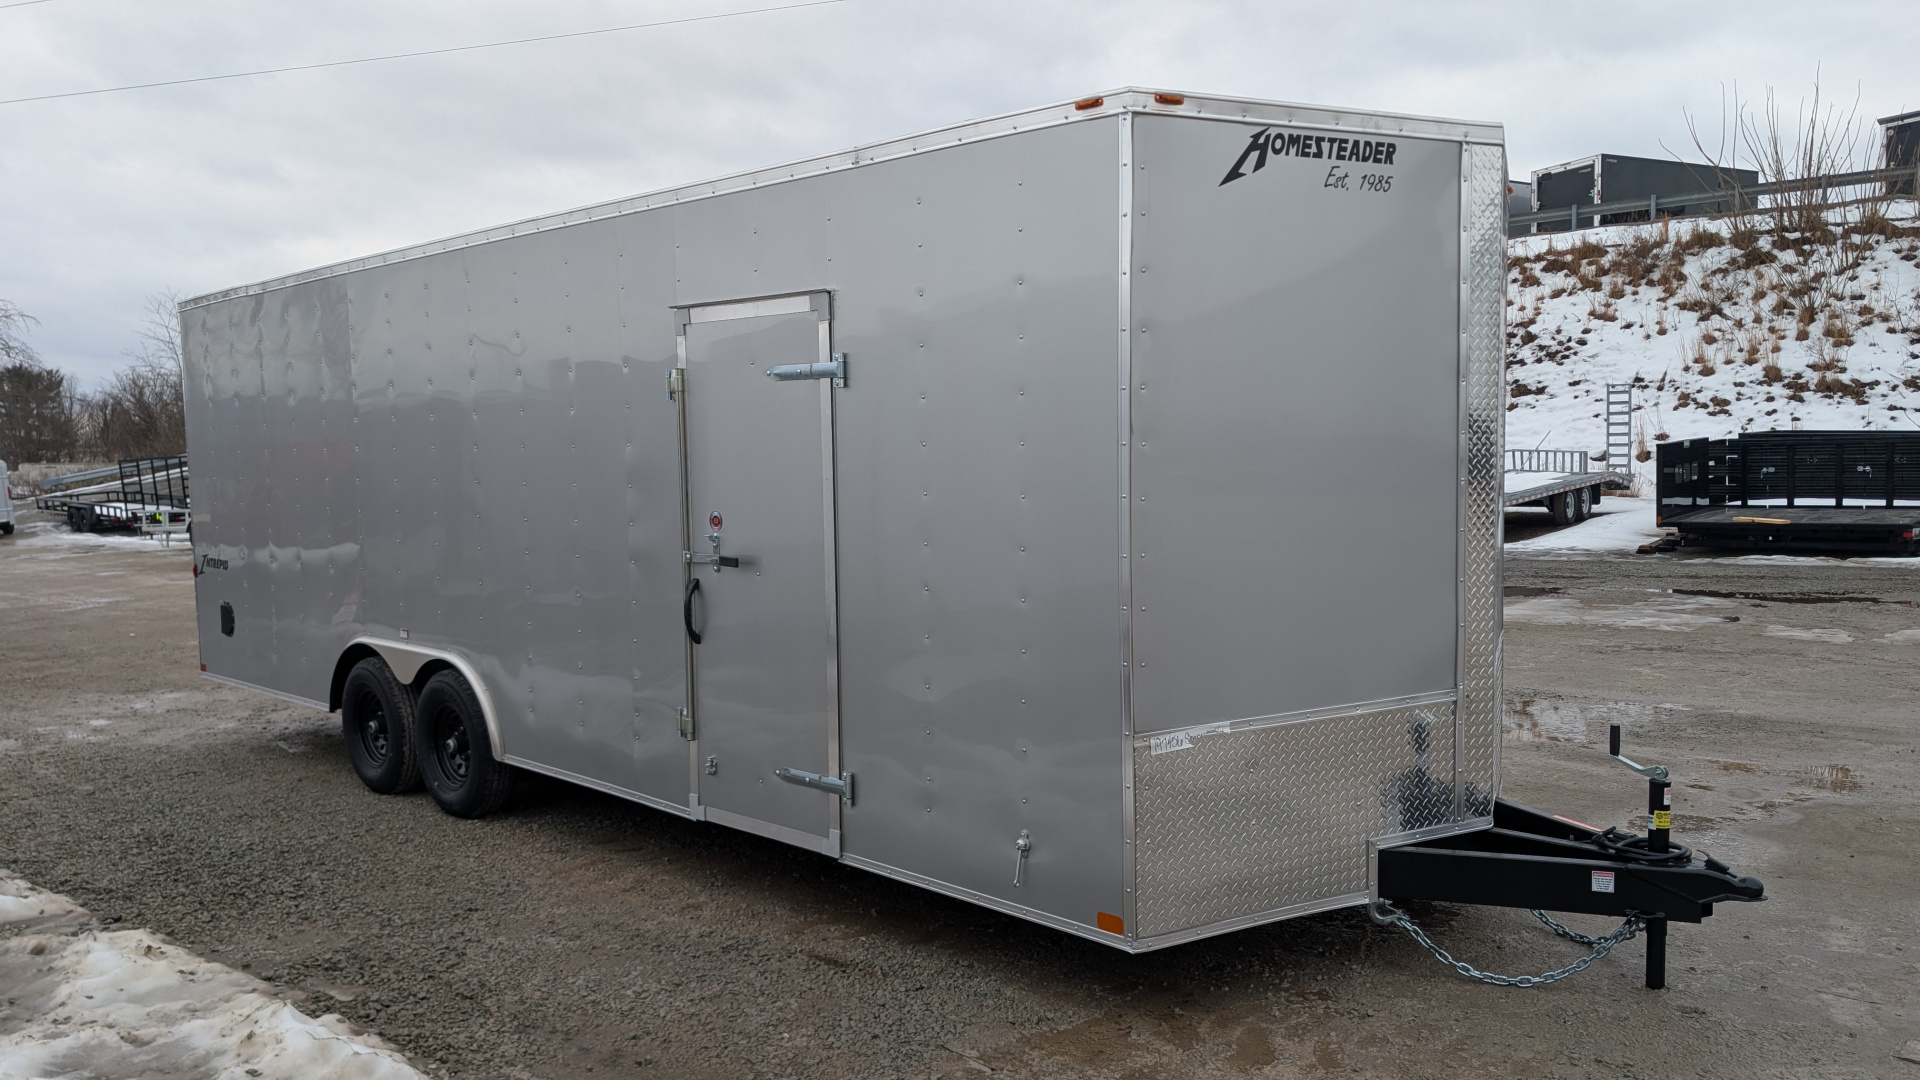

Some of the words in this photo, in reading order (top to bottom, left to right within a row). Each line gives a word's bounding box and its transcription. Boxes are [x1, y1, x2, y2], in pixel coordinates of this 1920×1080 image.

[1218, 126, 1397, 187] HOMESTEADER
[1359, 173, 1394, 193] 1985
[198, 553, 229, 575] INTREPID
